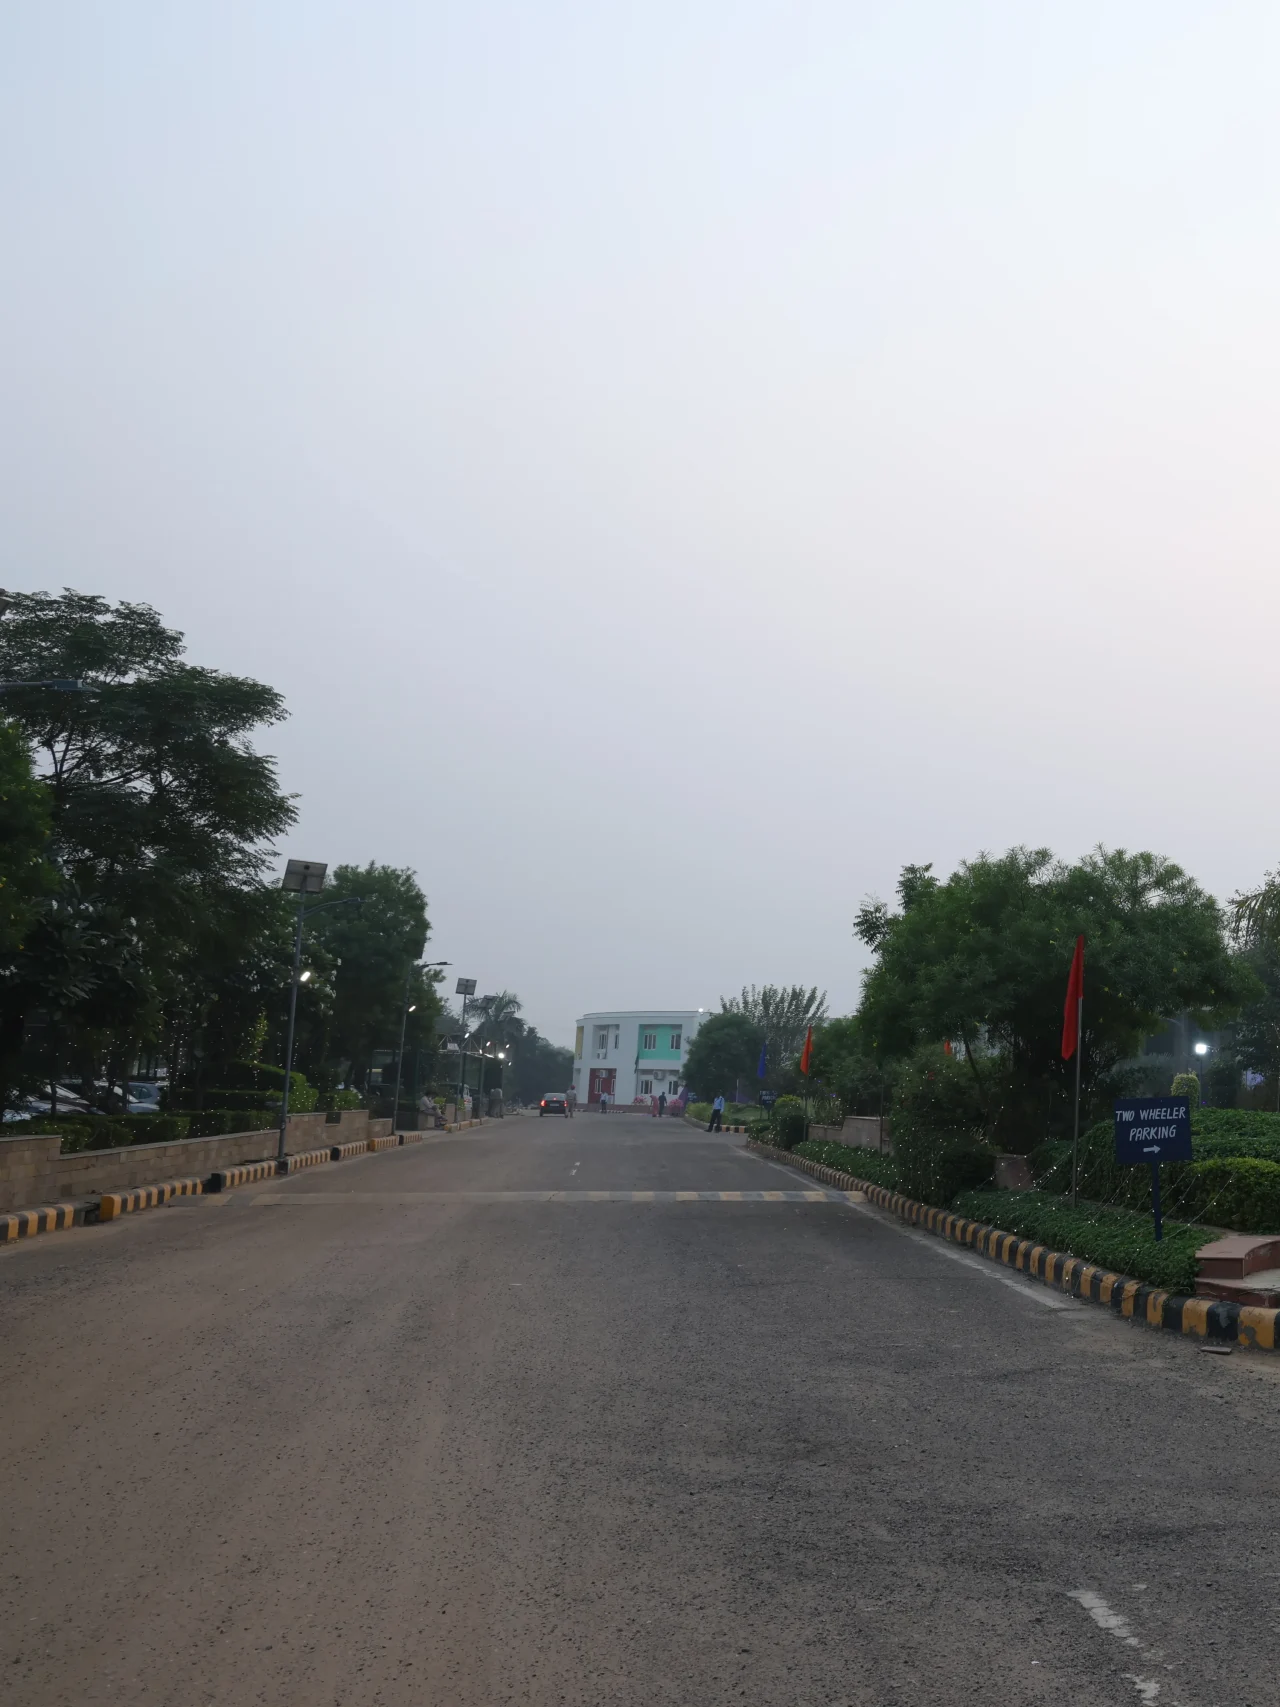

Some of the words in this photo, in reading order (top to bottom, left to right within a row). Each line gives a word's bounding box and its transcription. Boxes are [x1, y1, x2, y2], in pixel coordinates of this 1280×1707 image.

[1115, 1110, 1135, 1122] TWO
[1139, 1106, 1186, 1121] WHEELER
[1129, 1124, 1177, 1141] PARKING
